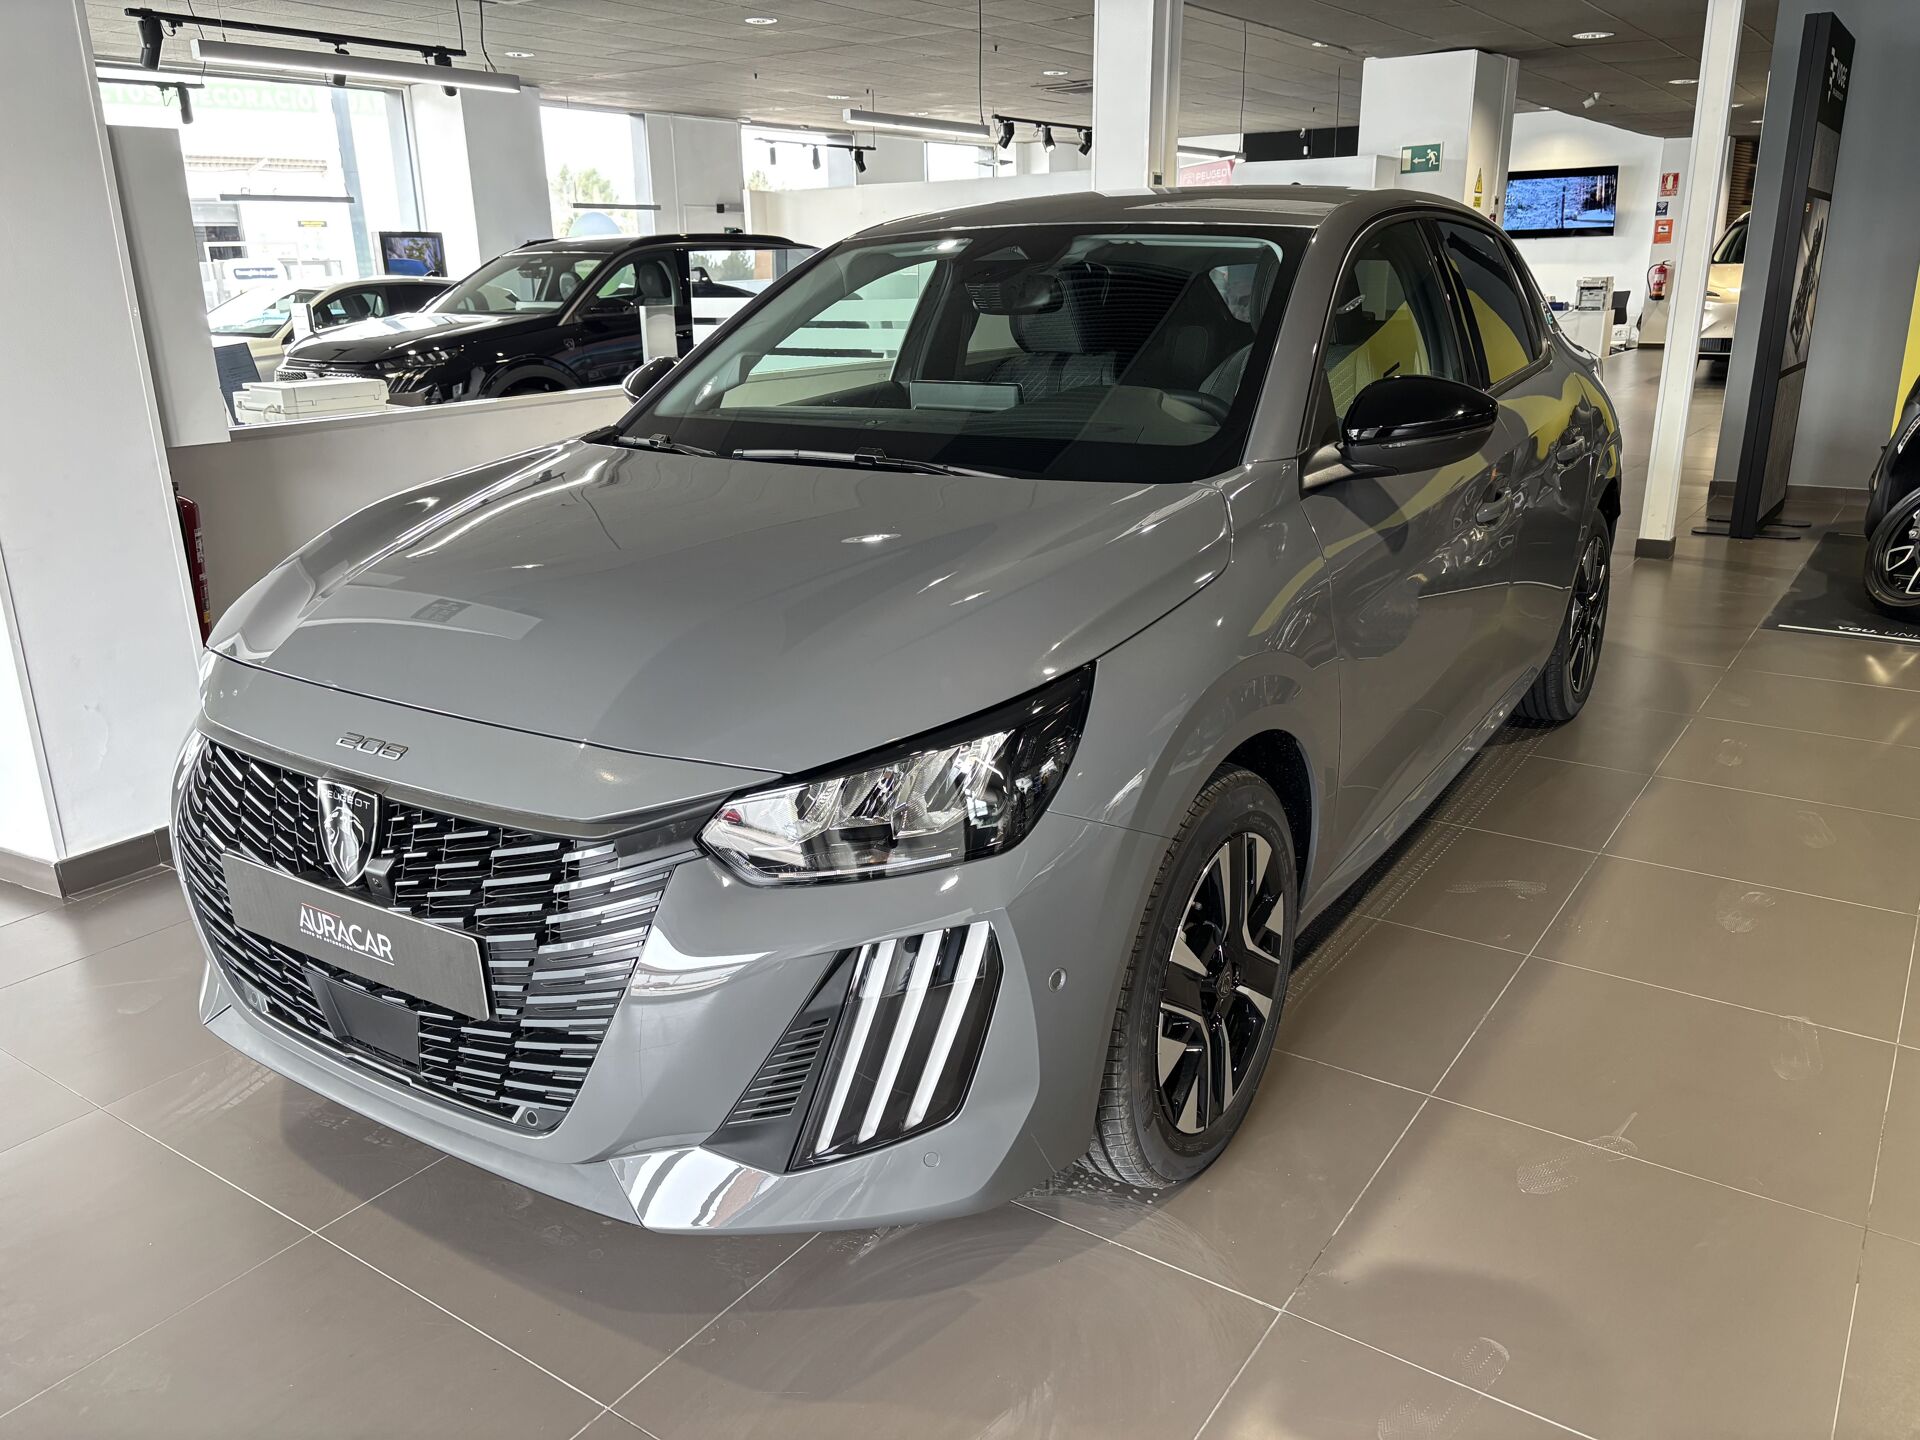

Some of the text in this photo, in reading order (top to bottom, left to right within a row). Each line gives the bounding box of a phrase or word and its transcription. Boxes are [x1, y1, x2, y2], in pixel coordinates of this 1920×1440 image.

[336, 731, 408, 761] 208
[323, 788, 371, 810] PEUGEOT
[300, 905, 394, 962] AURACAR
